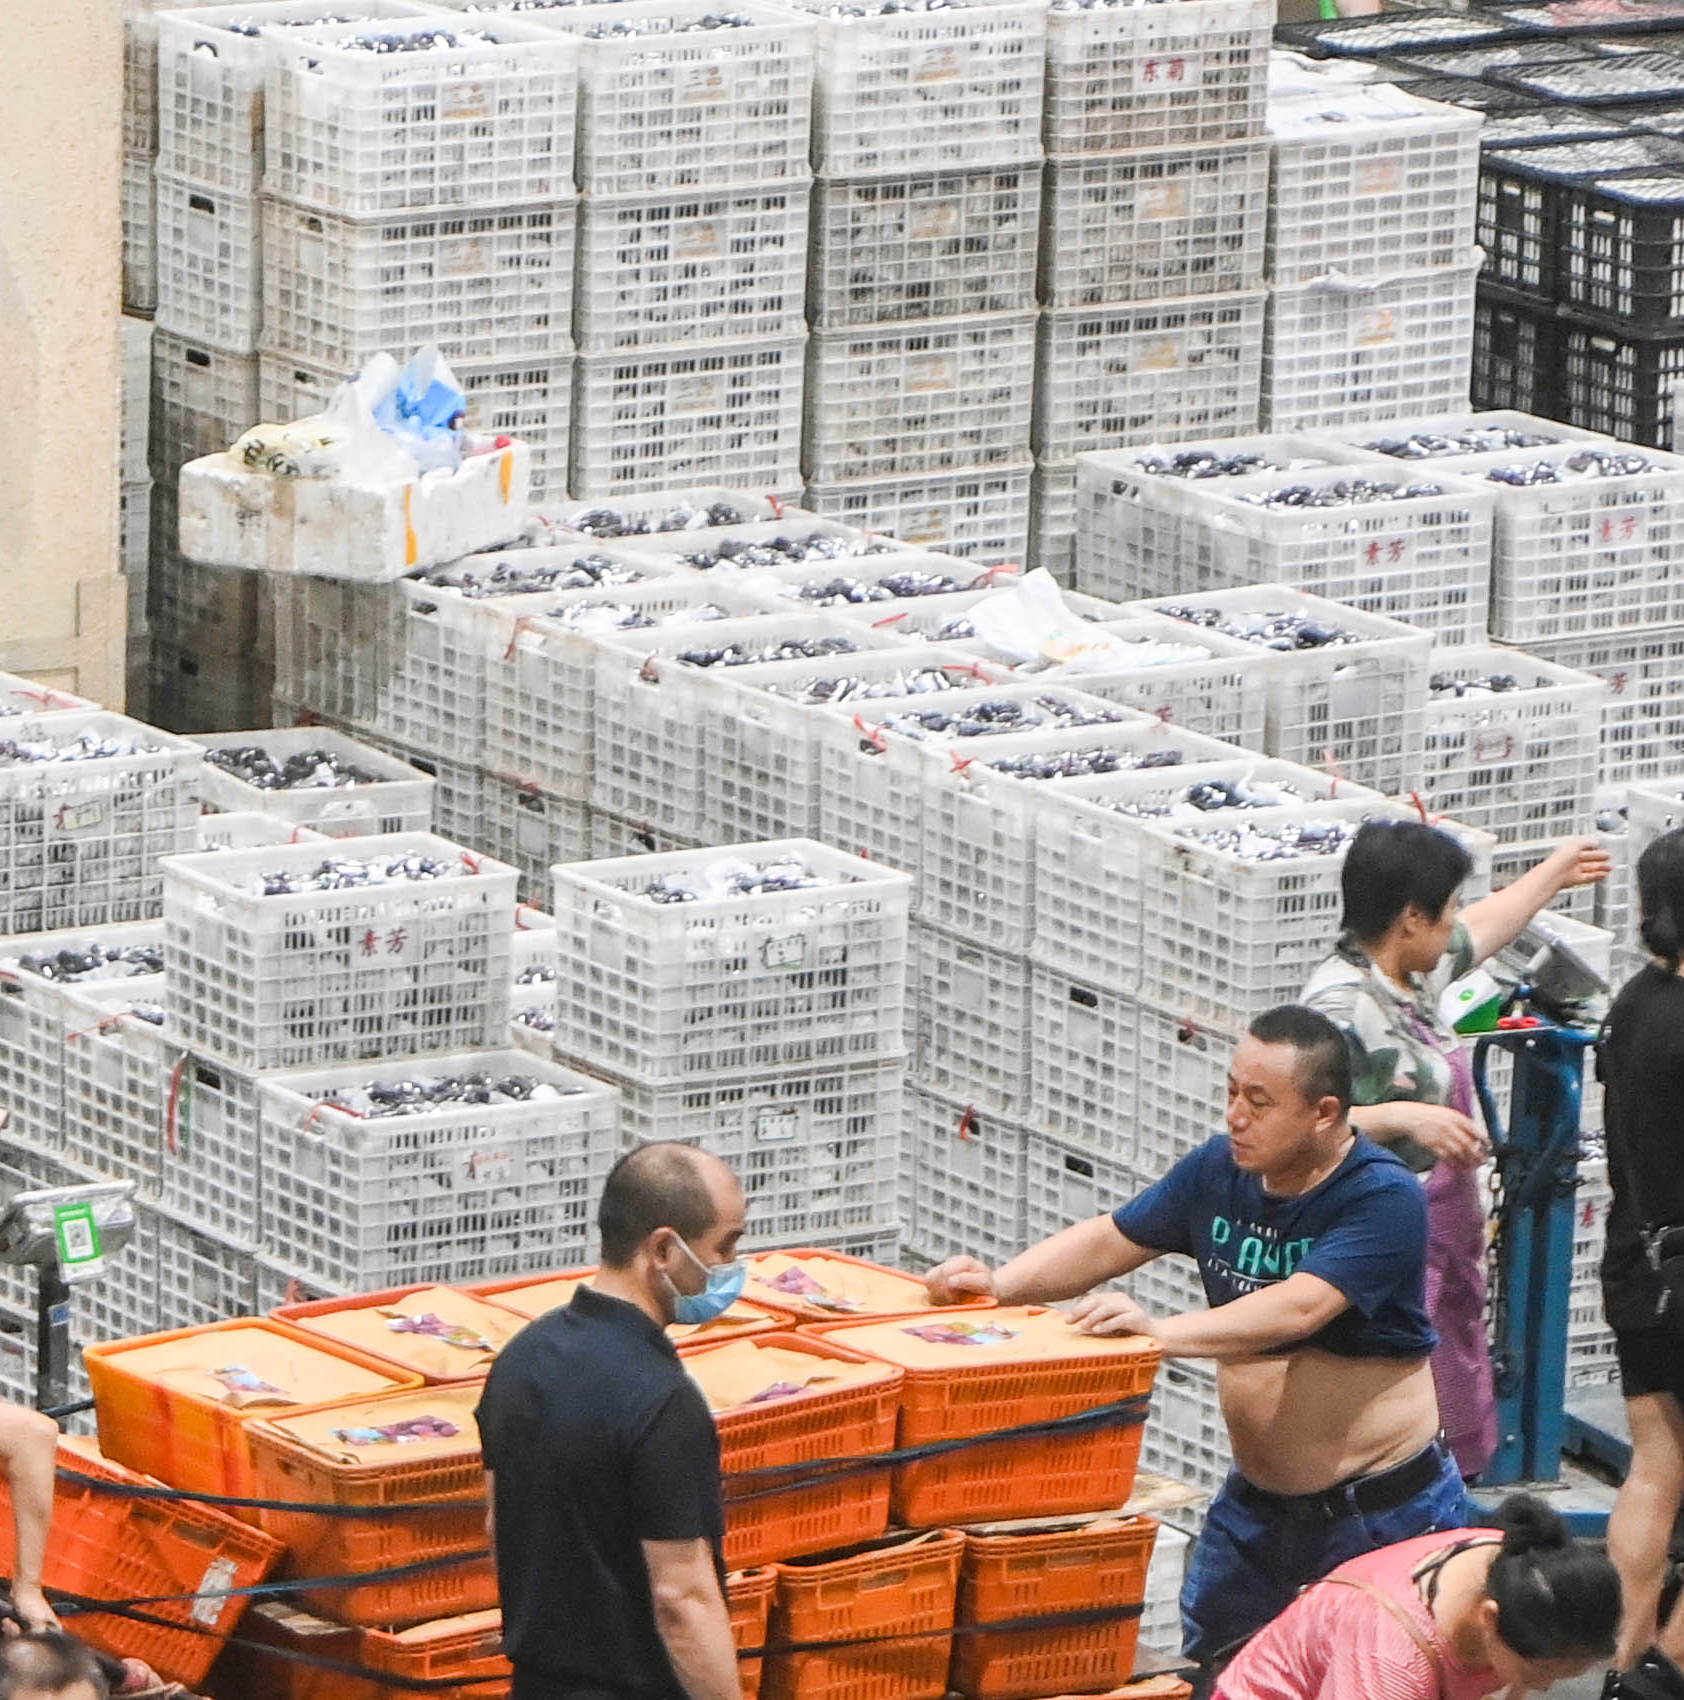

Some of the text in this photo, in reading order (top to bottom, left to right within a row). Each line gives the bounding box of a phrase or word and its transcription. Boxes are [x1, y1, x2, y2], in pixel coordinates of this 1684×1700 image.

[1143, 57, 1186, 84] 东菊
[1365, 538, 1406, 566] 素芳
[359, 926, 408, 958] 素芳
